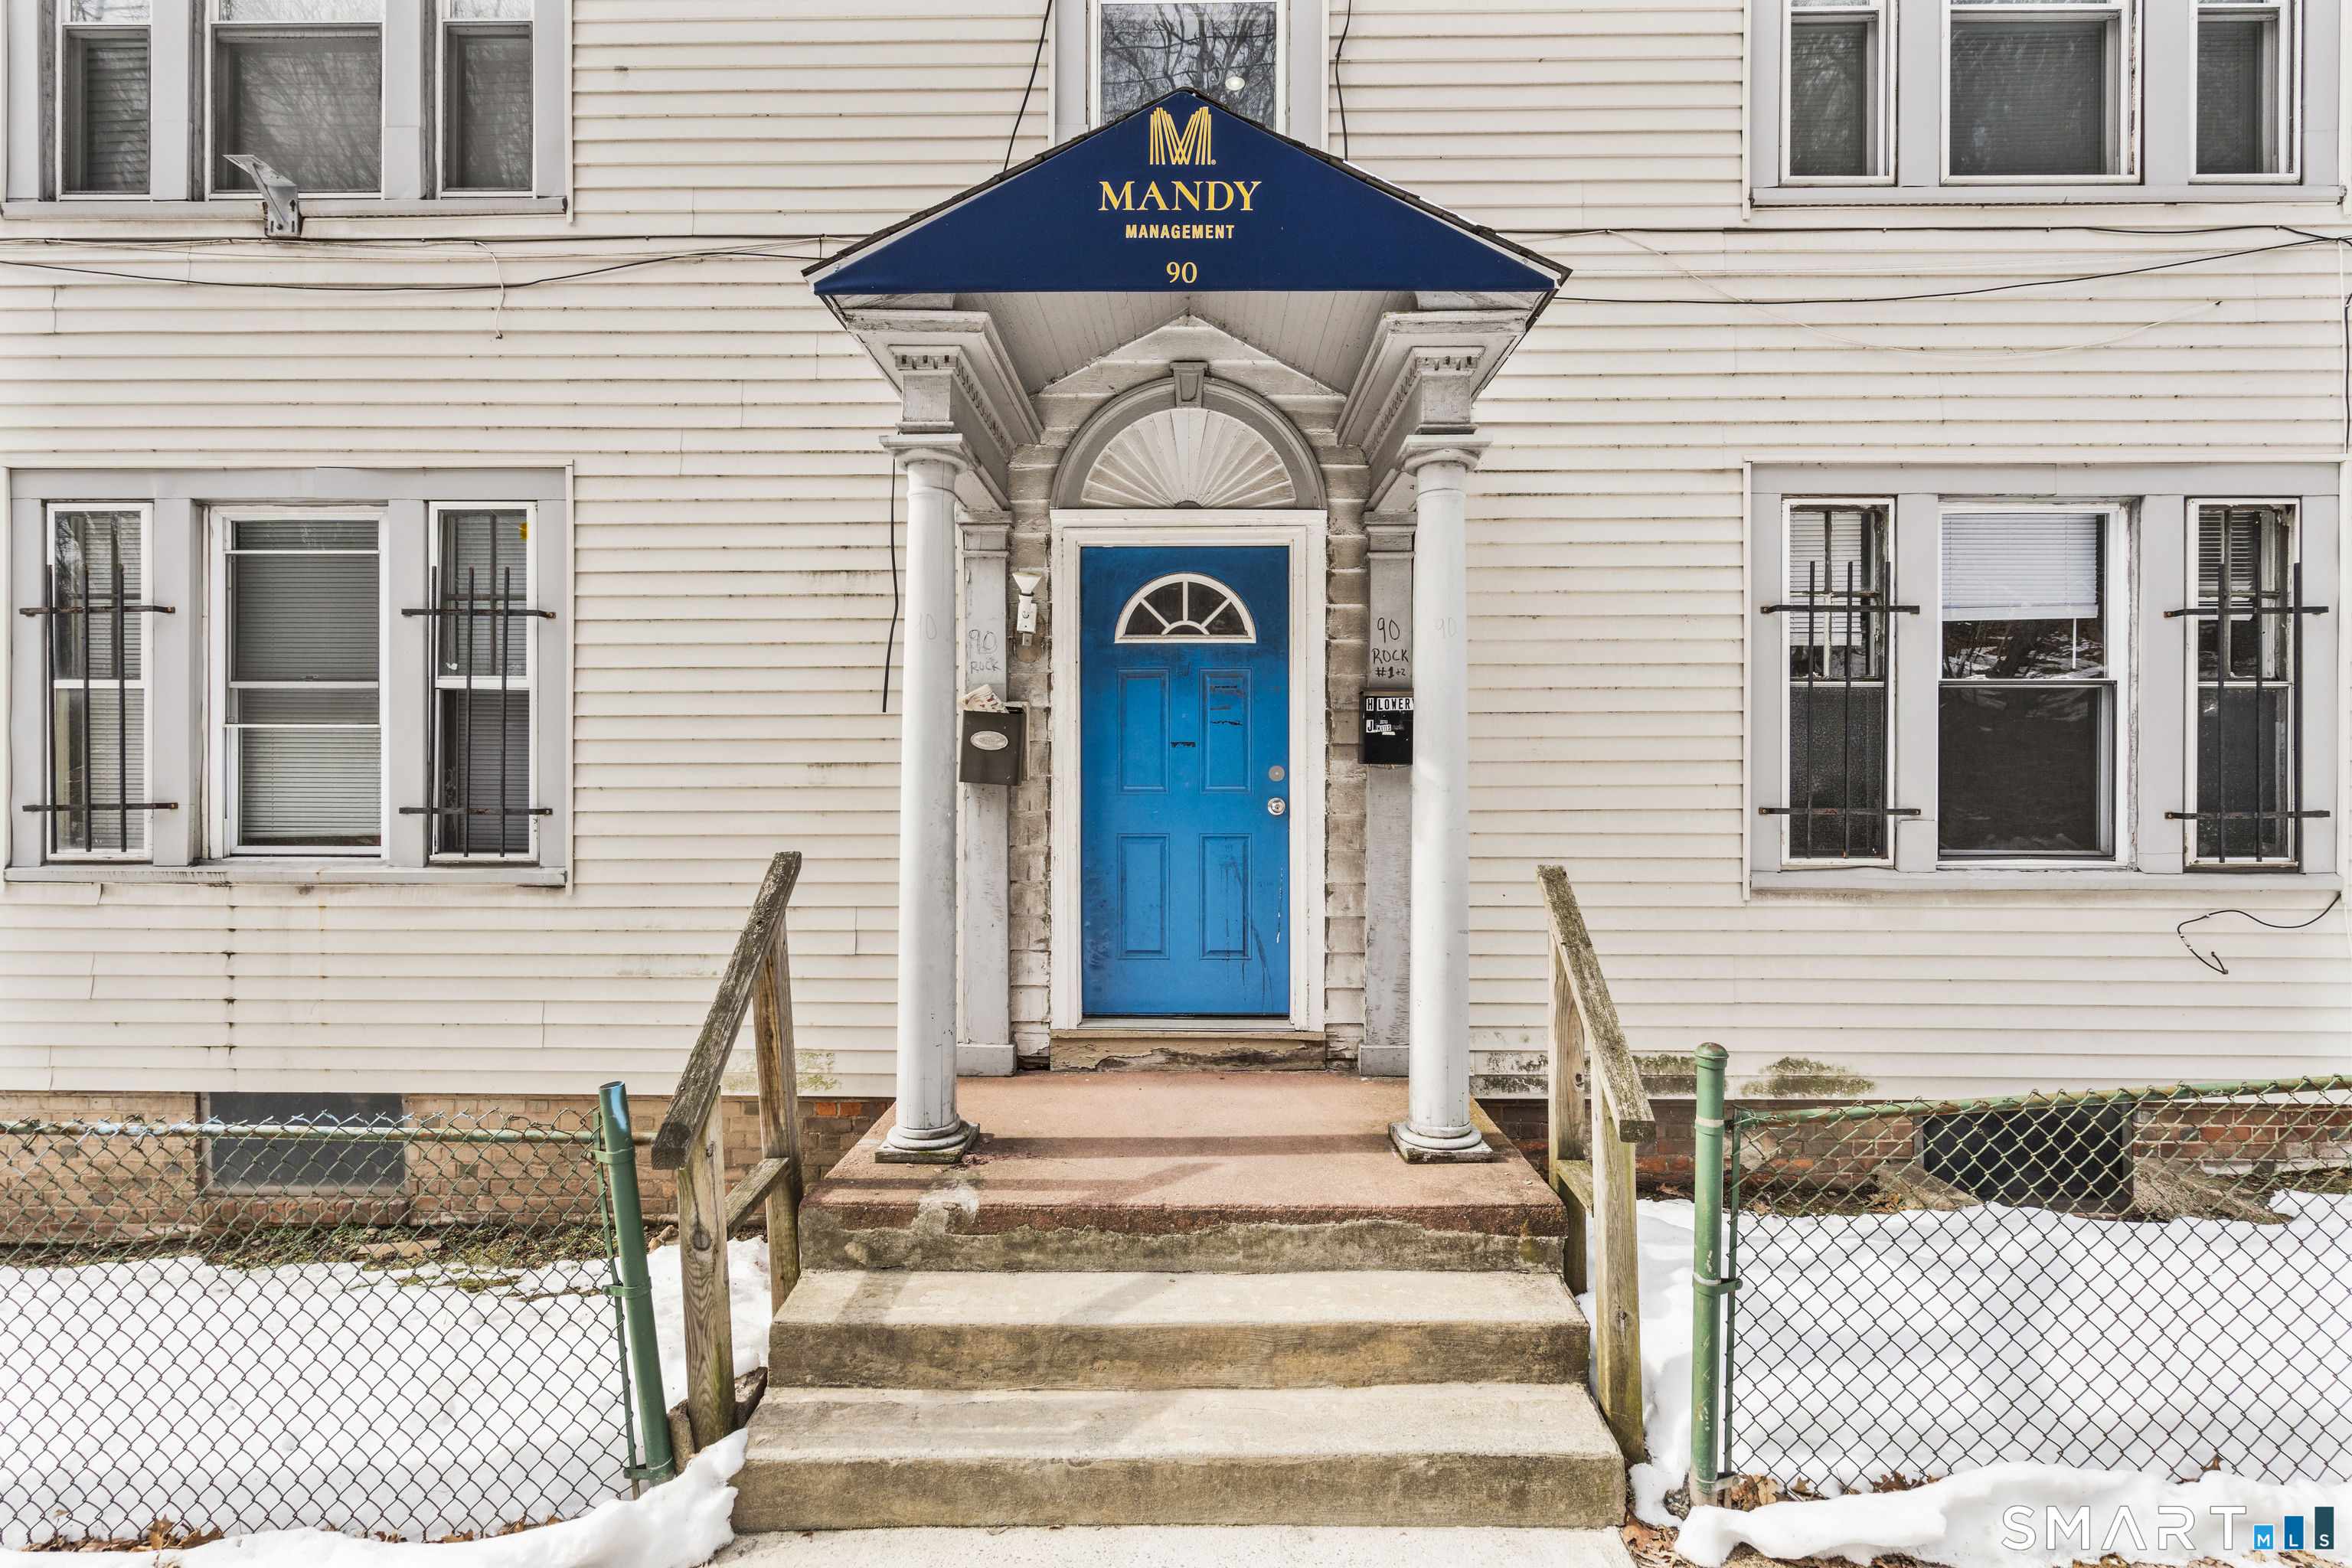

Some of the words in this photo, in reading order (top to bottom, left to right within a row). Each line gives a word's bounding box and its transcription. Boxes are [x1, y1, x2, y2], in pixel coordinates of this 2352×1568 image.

[1098, 181, 1262, 211] MANDY
[1125, 224, 1235, 239] MANAGEMENT
[1166, 261, 1197, 283] 90
[913, 612, 937, 640] 90
[1377, 617, 1400, 643] 90
[1436, 617, 1456, 639] 90
[969, 629, 998, 655] 90
[970, 658, 1002, 674] ROCK
[1371, 648, 1410, 665] ROCK
[1367, 698, 1374, 710] H
